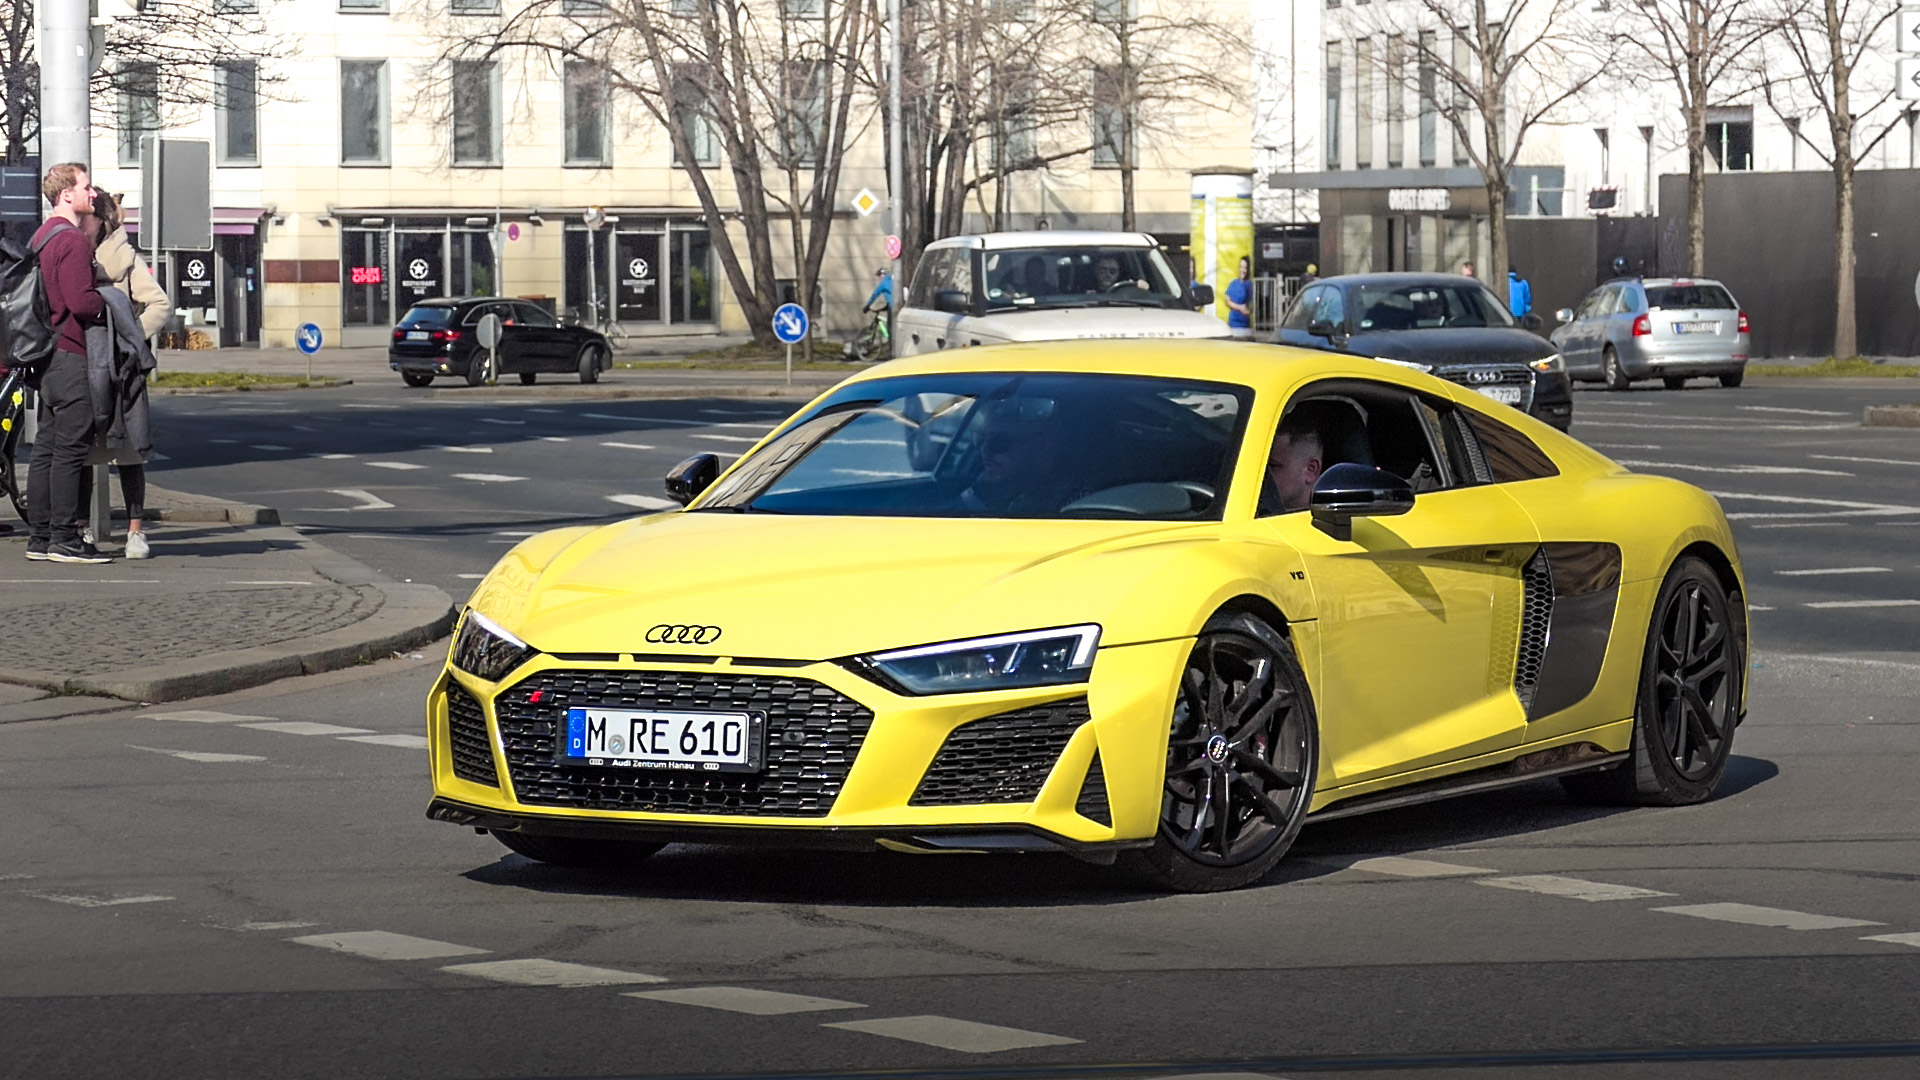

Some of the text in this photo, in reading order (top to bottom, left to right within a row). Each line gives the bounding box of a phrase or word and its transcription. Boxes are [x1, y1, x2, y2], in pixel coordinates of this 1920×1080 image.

[352, 273, 381, 284] OPEN
[1289, 570, 1305, 580] V10
[587, 716, 742, 757] M RE 610
[573, 738, 581, 749] D
[612, 759, 695, 770] Audi Zentrum Hanau
